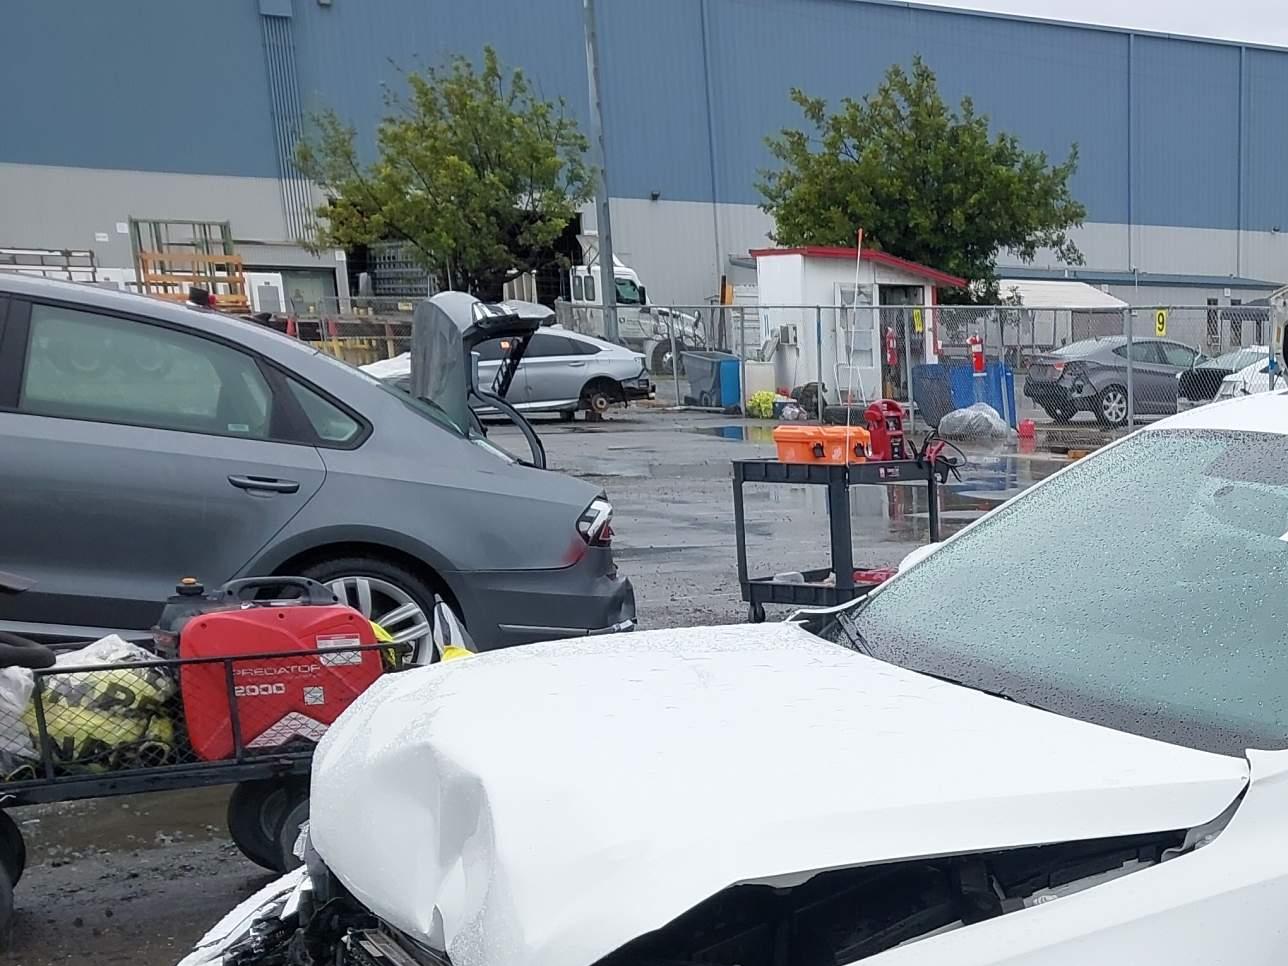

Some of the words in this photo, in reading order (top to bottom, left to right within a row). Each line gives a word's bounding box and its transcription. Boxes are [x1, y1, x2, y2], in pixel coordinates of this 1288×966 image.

[1157, 312, 1165, 332] 9
[232, 664, 321, 676] PREDATOR
[234, 683, 285, 697] 2000
